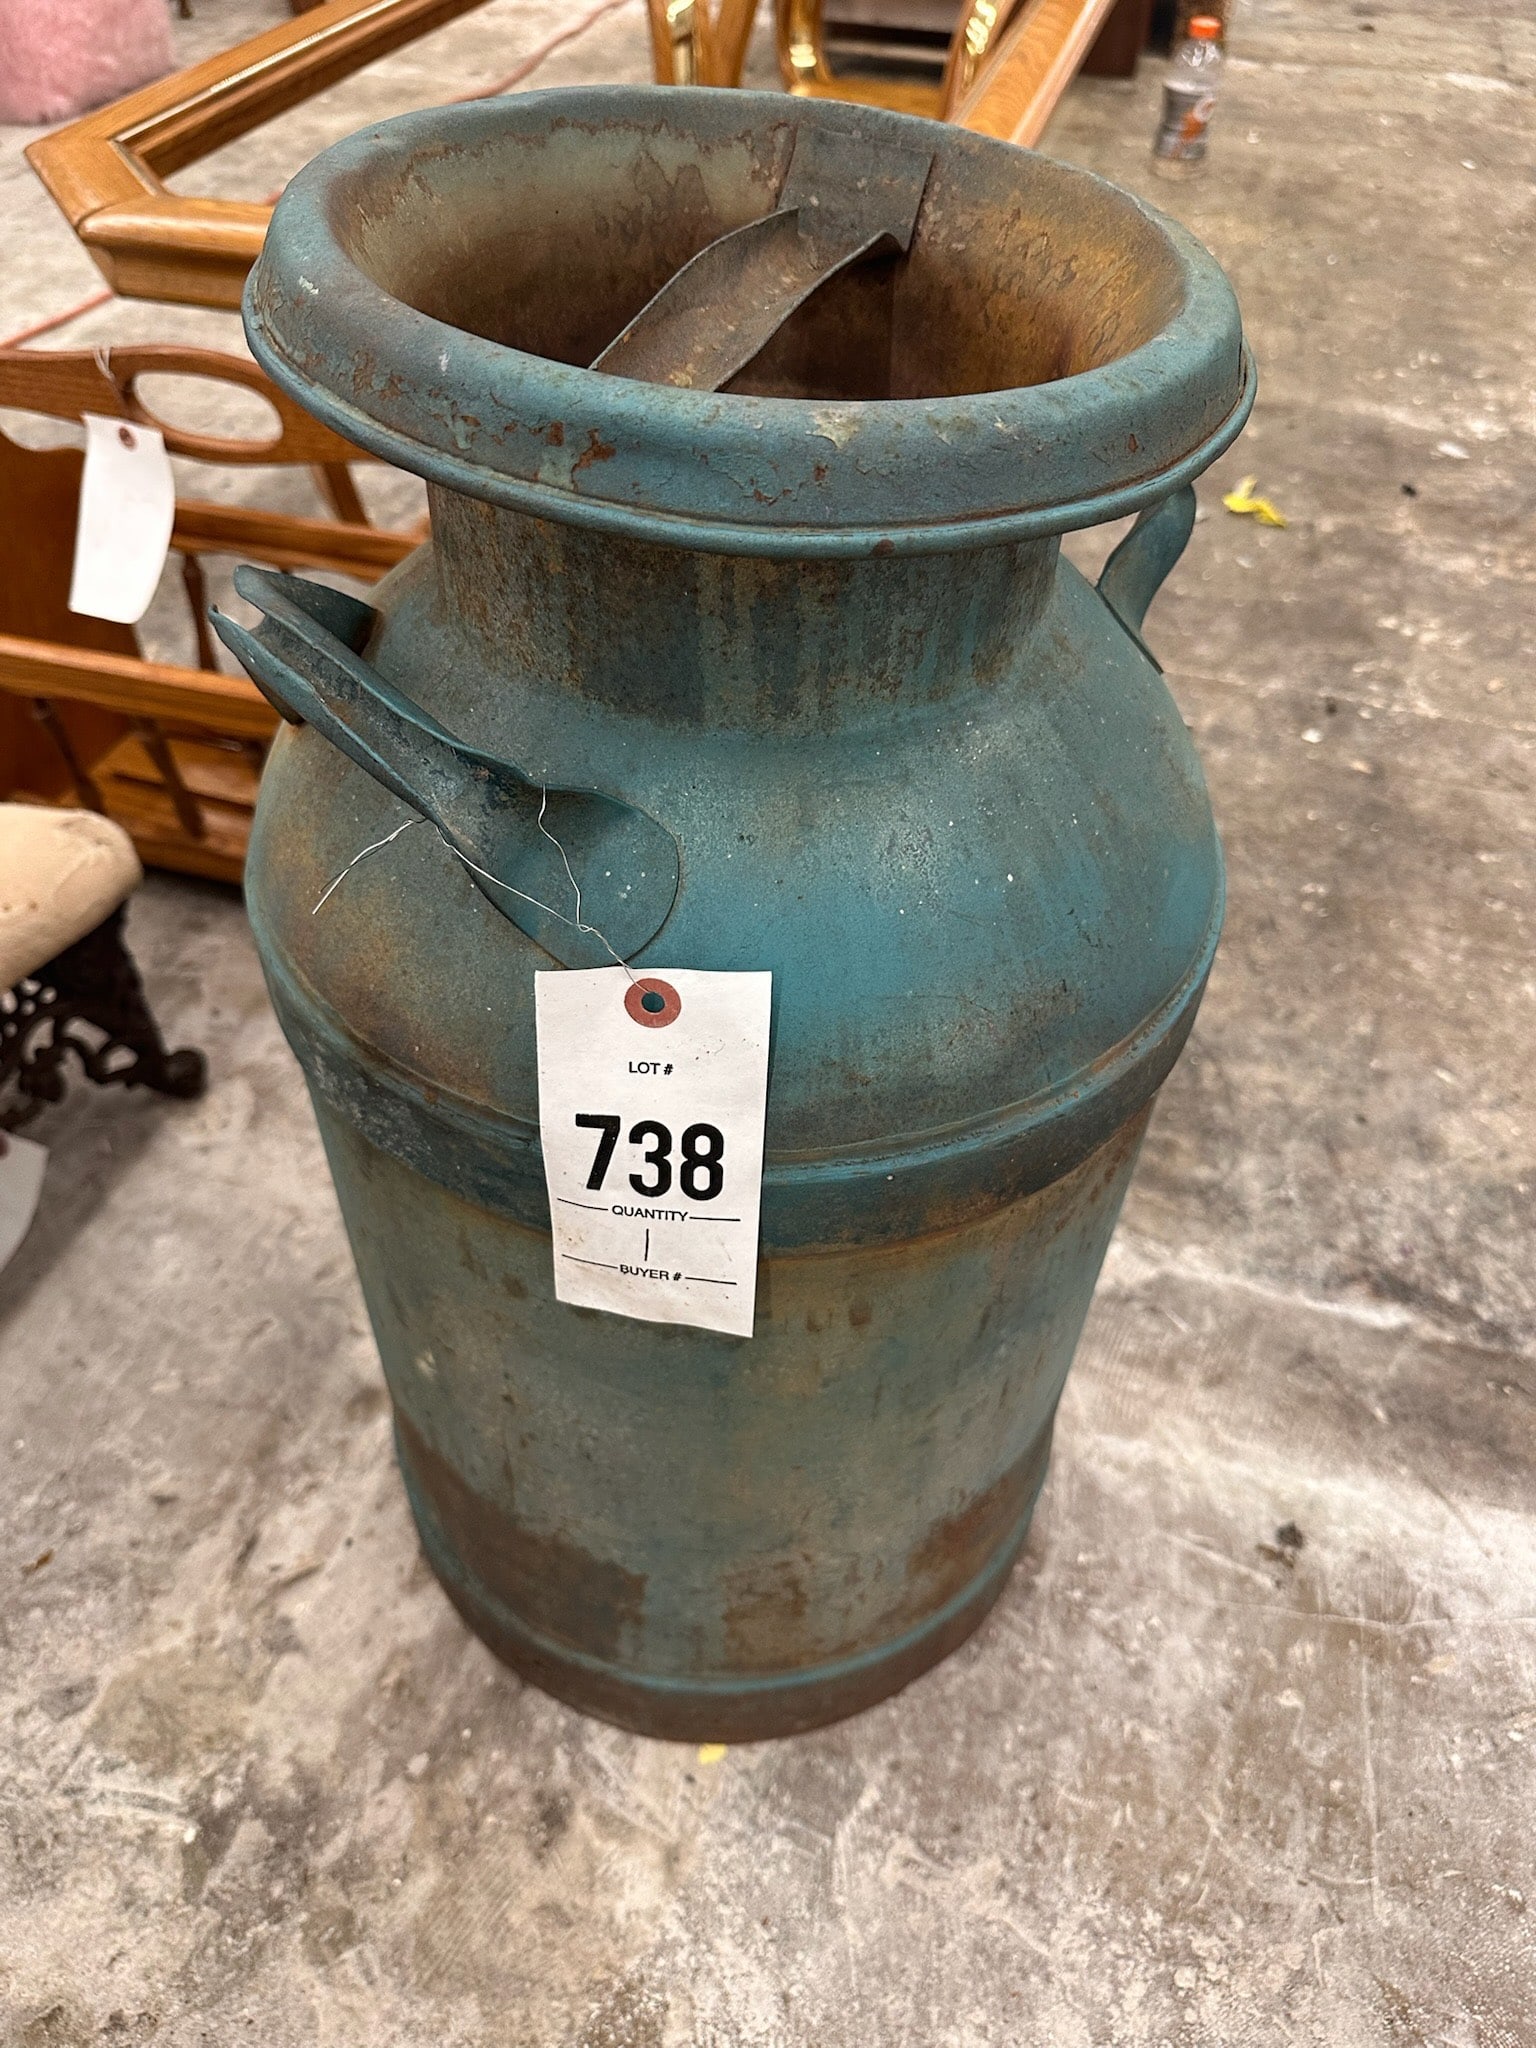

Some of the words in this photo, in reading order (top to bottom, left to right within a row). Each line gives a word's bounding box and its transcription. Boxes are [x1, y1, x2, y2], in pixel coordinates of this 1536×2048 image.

[628, 1061, 660, 1075] LOT
[663, 1063, 674, 1076] #
[575, 1113, 725, 1202] 738
[611, 1204, 689, 1222] QUANTITY
[619, 1264, 670, 1281] BUYER
[673, 1271, 682, 1282] #
